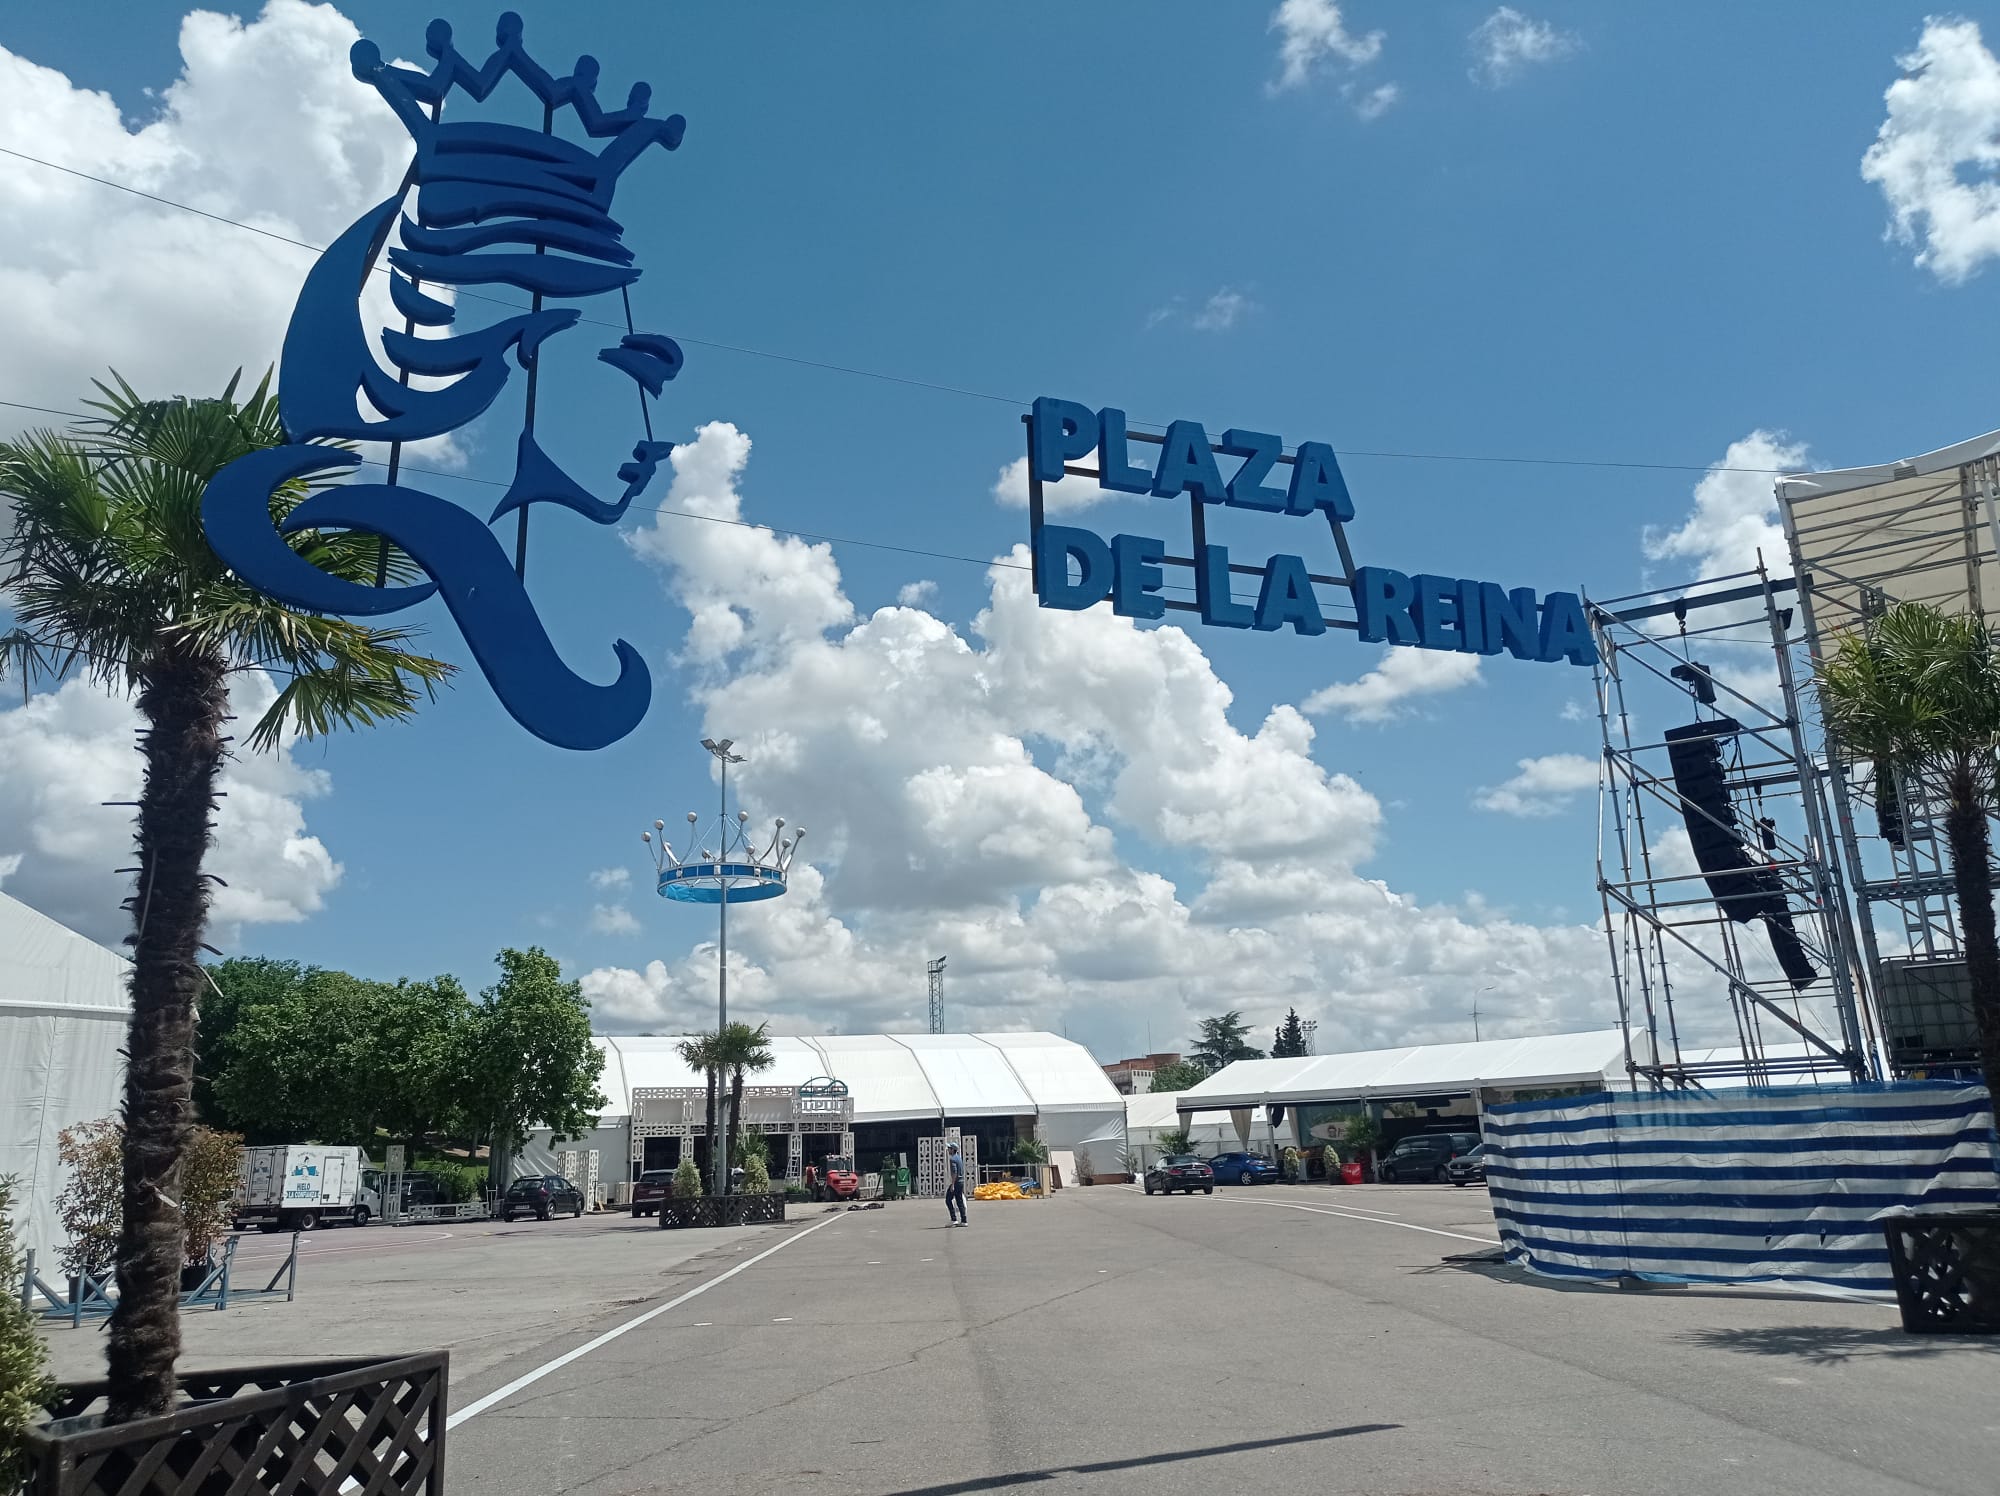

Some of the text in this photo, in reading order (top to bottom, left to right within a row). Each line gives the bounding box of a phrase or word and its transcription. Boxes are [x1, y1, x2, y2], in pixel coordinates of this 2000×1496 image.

[1032, 396, 1355, 522] PLAZA
[1037, 524, 1600, 667] DE LA REINA
[296, 1183, 311, 1191] HIELO
